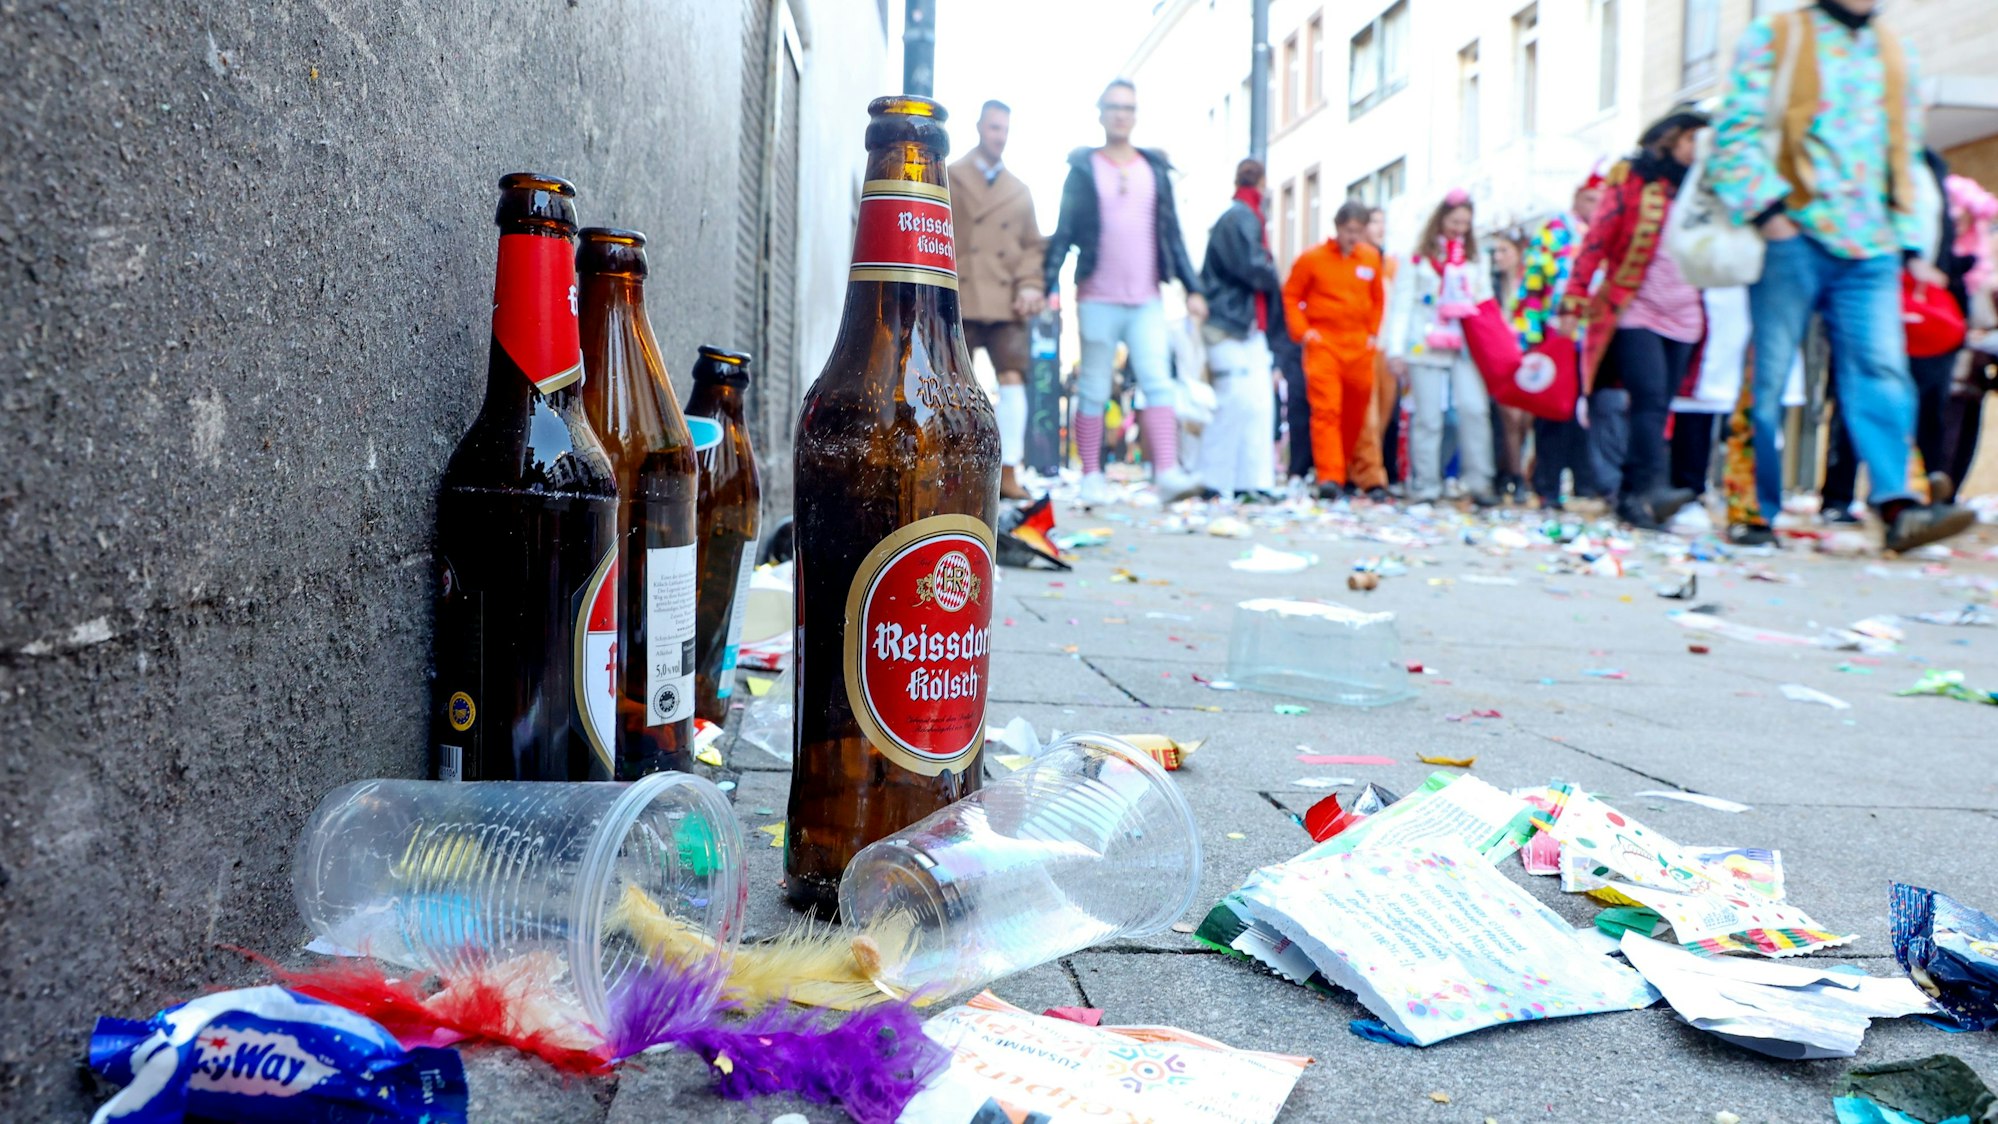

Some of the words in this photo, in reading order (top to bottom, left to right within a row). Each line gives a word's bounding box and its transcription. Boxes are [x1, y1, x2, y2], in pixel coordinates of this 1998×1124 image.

[917, 235, 953, 261] Kölsch
[655, 663, 667, 677] 5,0
[906, 664, 979, 702] Kölsch
